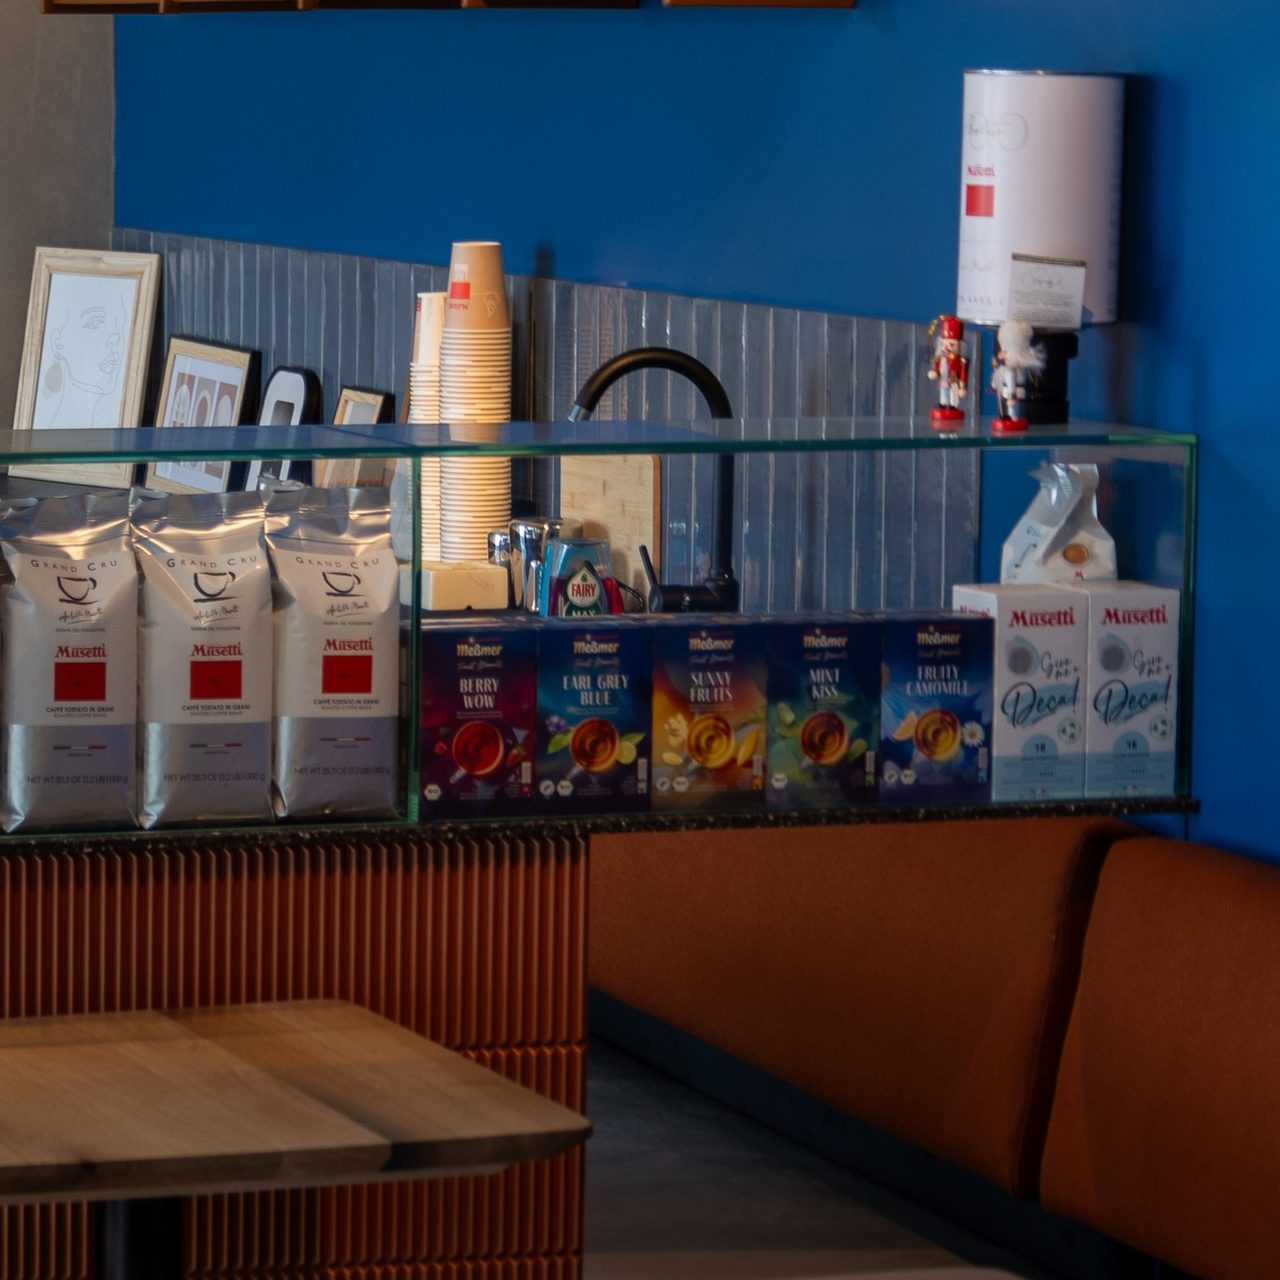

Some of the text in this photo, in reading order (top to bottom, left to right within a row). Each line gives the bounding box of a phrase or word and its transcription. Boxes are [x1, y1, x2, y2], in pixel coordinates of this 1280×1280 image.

[87, 560, 117, 571] CRU
[228, 556, 257, 566] CRU
[350, 558, 379, 570] CRU
[571, 583, 597, 597] FAIRY
[1009, 607, 1075, 627] Musetti
[1102, 605, 1168, 626] Musetti
[55, 644, 107, 658] Musetti
[190, 642, 243, 656] Musetti
[323, 637, 373, 651] Musetti
[457, 643, 503, 657] Meßmer
[690, 671, 731, 686] SUNNY
[810, 668, 840, 683] MINT
[917, 665, 958, 680] FRUITY
[460, 678, 499, 693] BERRY
[563, 674, 629, 690] EARL GREY
[580, 690, 611, 706] BLUE
[690, 687, 733, 703] FRUITS
[812, 685, 838, 699] KISS
[1093, 673, 1172, 726] Deca!
[463, 694, 495, 709] WOW
[1001, 676, 1080, 729] Deca!
